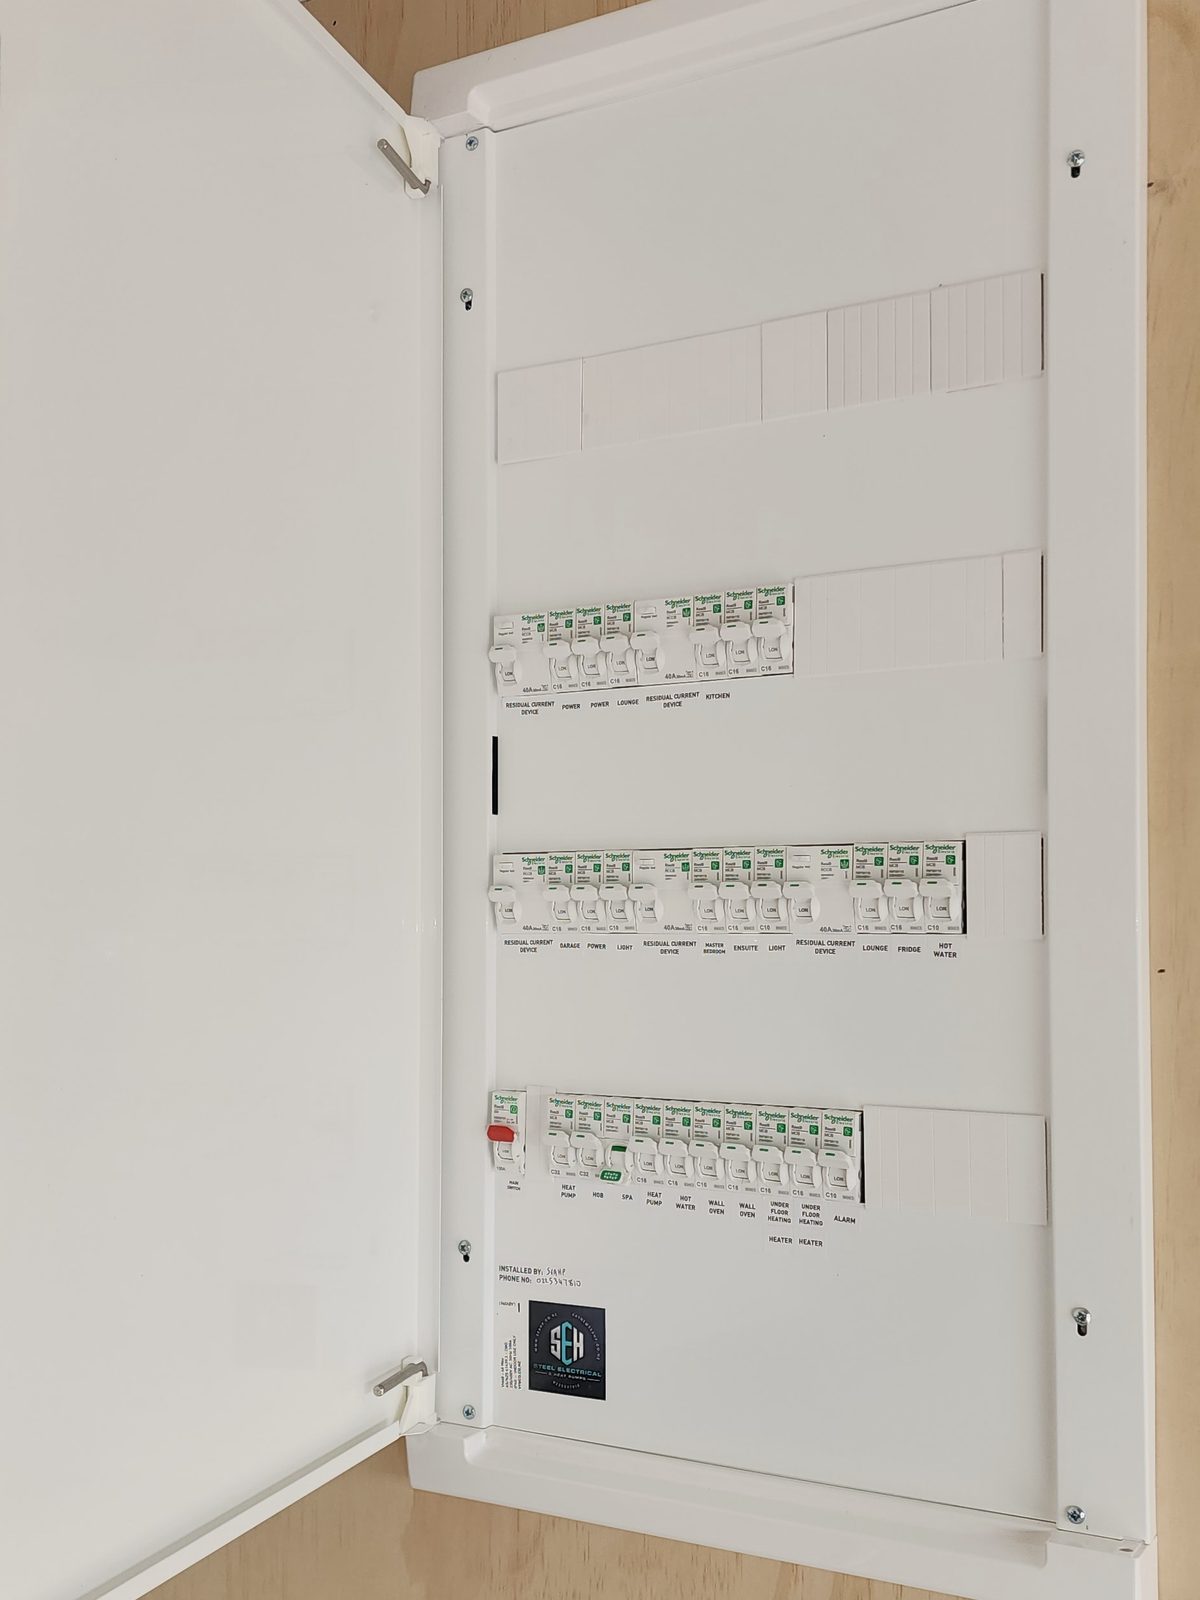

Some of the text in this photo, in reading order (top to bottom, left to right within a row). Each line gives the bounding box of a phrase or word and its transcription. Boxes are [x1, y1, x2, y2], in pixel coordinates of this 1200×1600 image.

[834, 1216, 855, 1224] ALARM
[769, 1236, 792, 1244] HEATER
[499, 1266, 532, 1274] INSTALLED
[551, 1321, 584, 1366] SEH
[558, 1366, 602, 1377] ELECTRICAL
